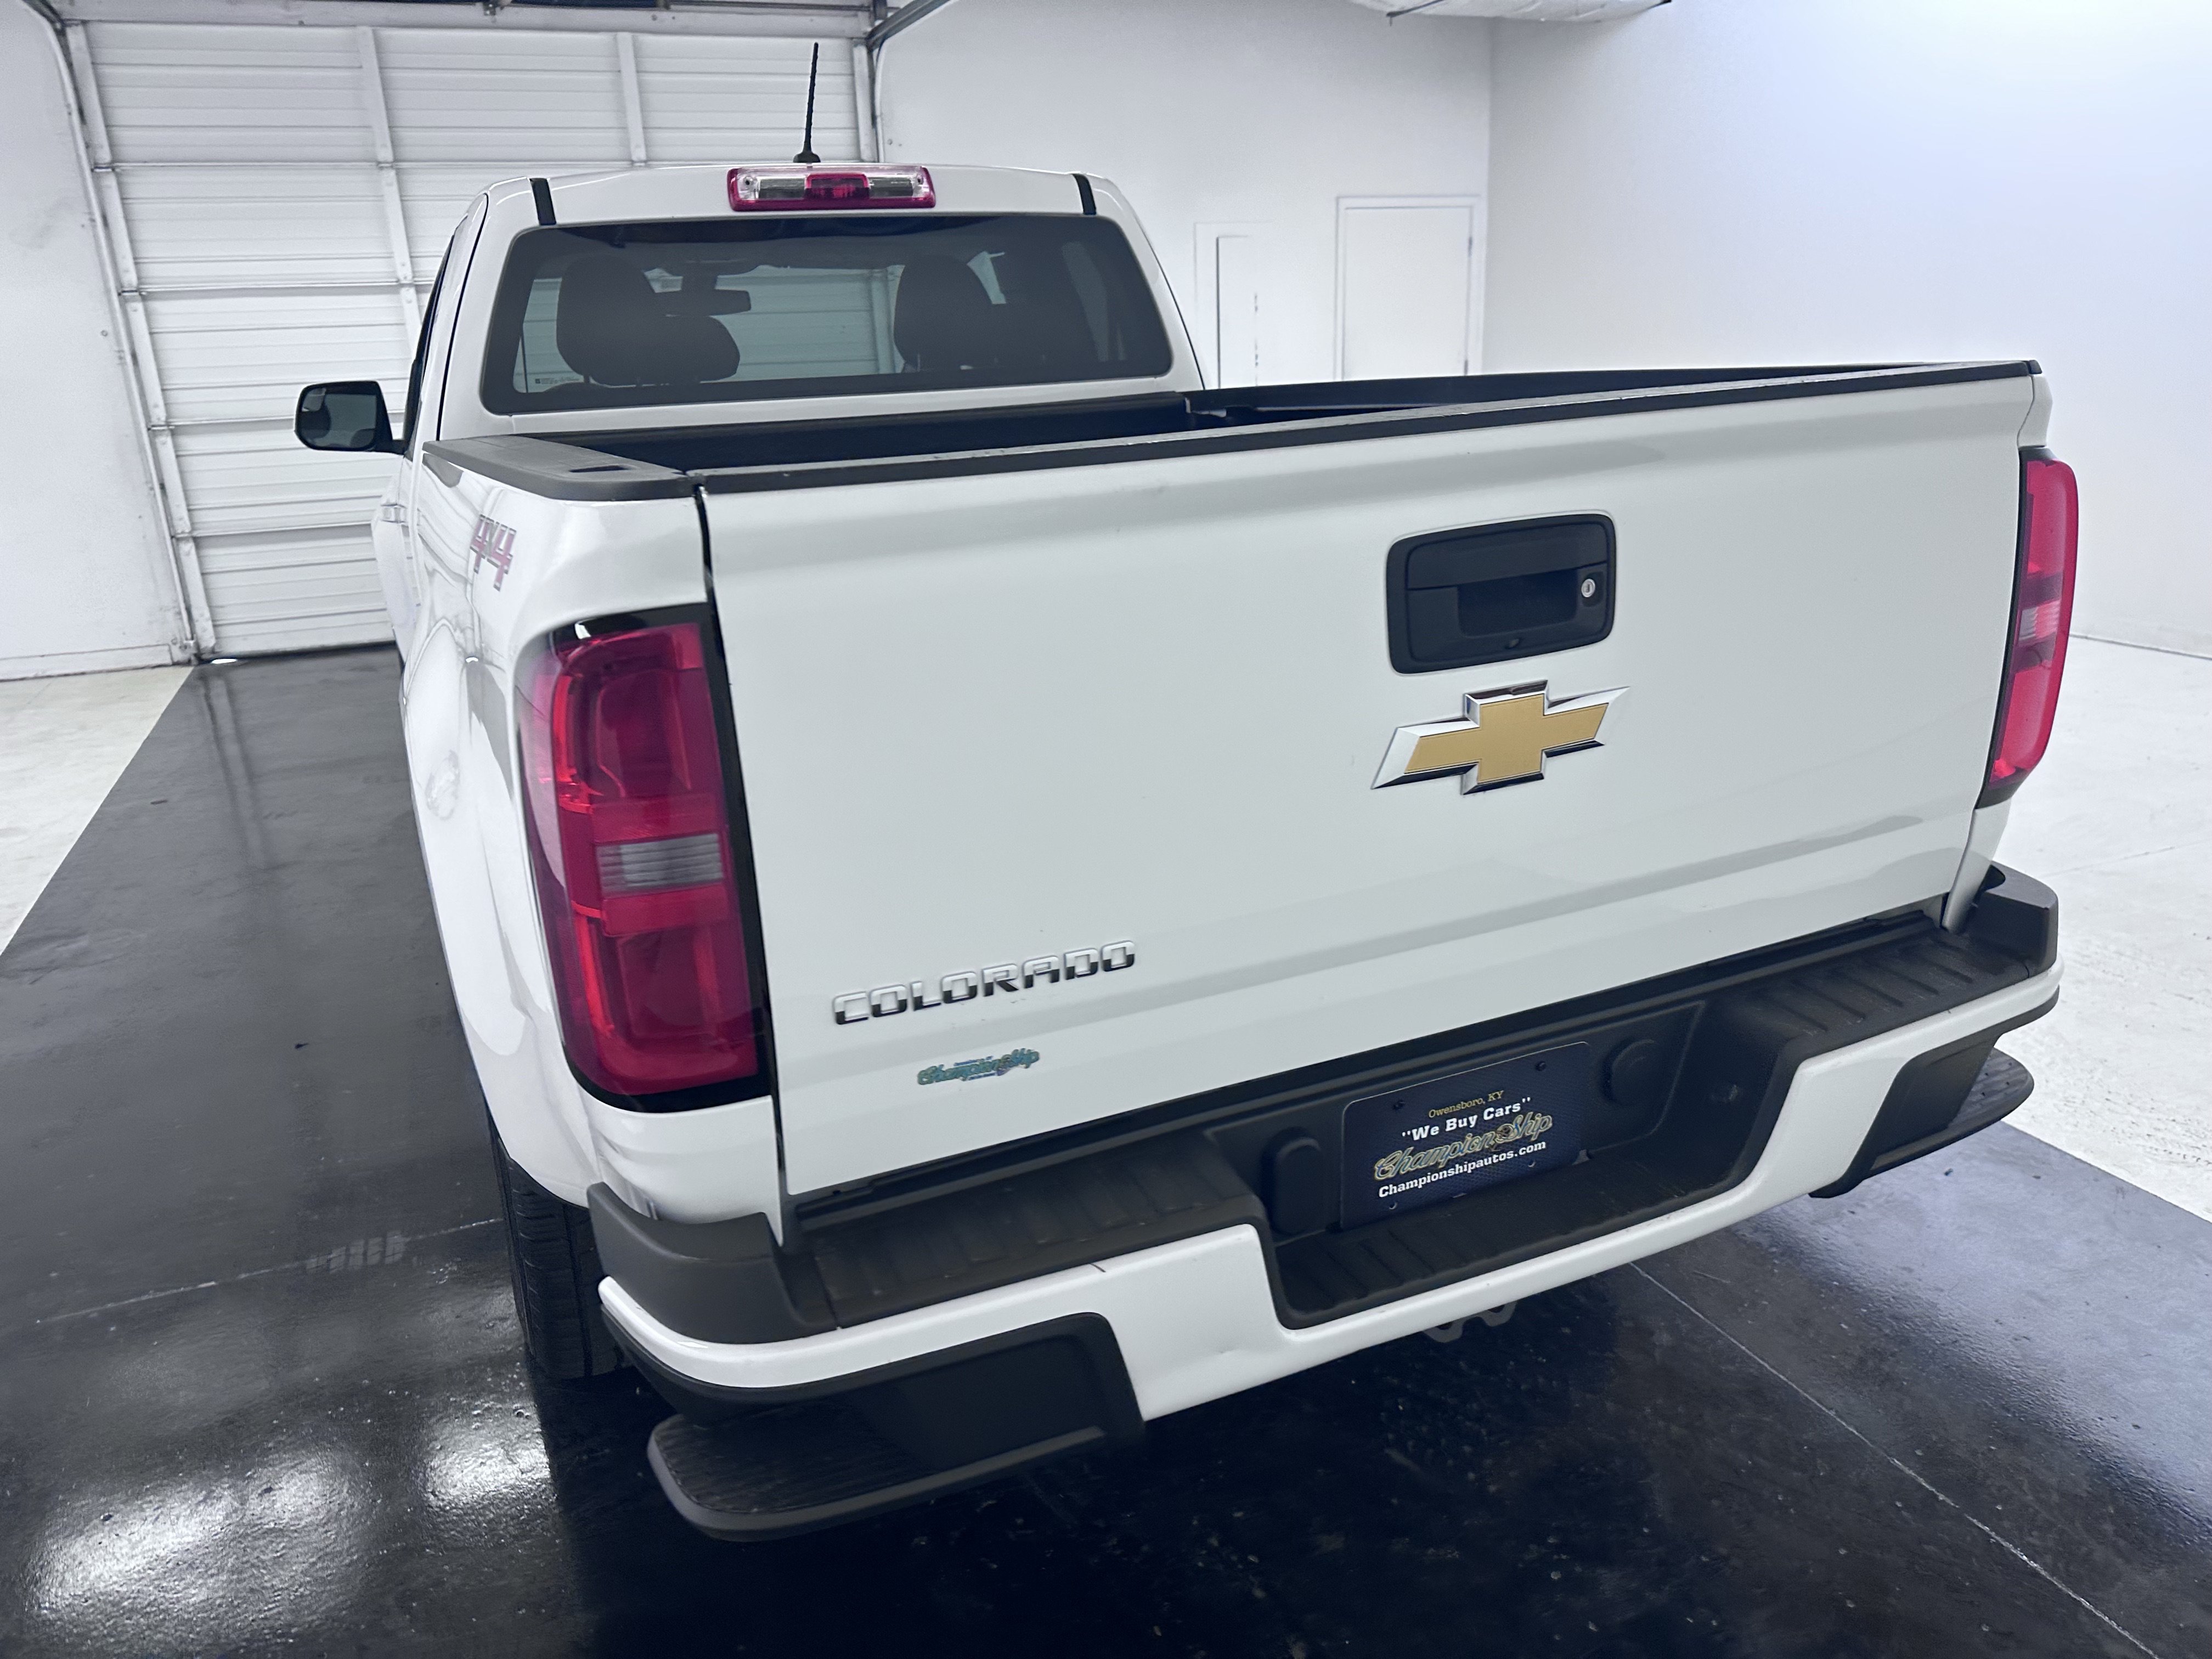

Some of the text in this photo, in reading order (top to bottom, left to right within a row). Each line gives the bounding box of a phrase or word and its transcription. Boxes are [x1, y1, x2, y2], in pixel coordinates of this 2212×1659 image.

[832, 939, 1136, 1025] COLORADO
[1429, 1090, 1504, 1118] Owensboro, KY
[1445, 1115, 1478, 1132] Buy
[1378, 1141, 1547, 1198] Championshipautos.com
